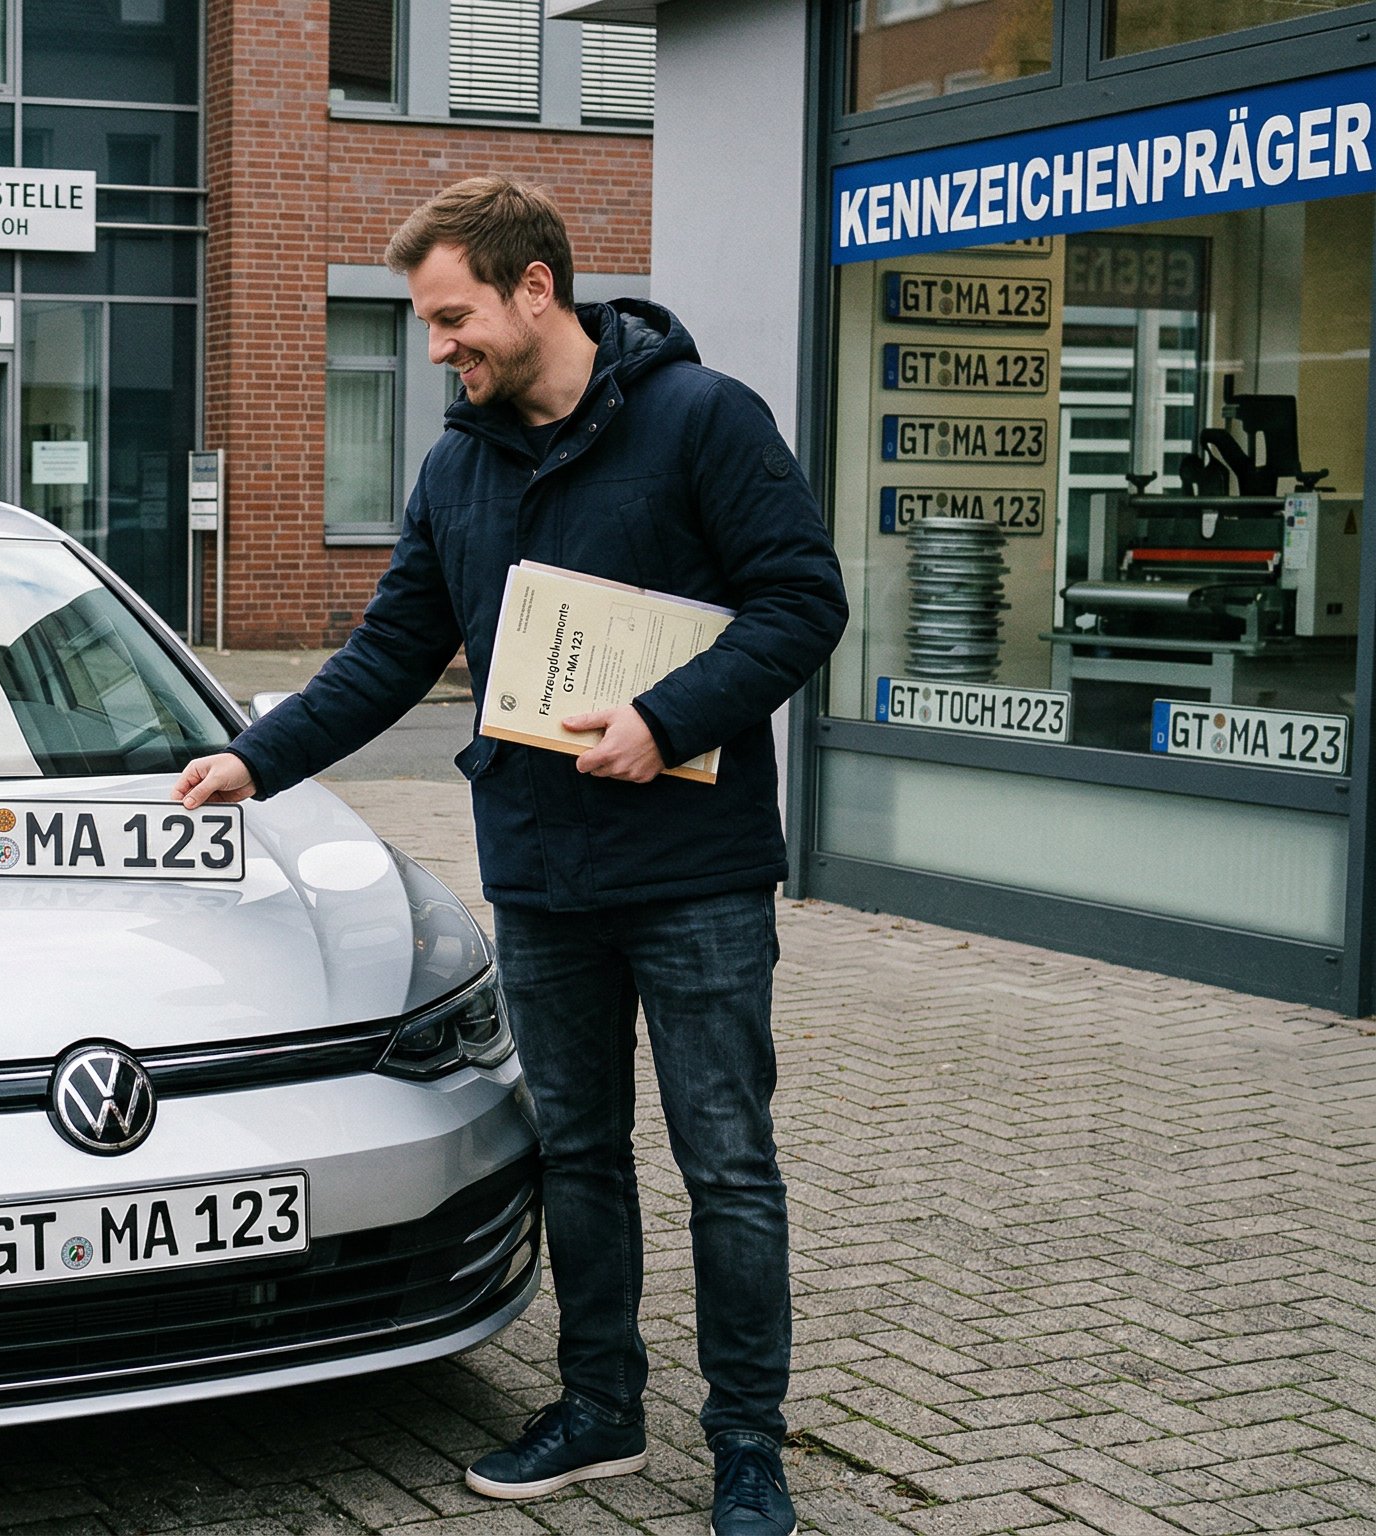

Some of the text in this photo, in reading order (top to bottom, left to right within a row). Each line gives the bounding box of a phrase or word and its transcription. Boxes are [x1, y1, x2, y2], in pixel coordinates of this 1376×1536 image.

[839, 102, 1372, 247] KENNZEICHENPRÄGER
[902, 279, 1047, 317] GT MA 123
[901, 351, 1045, 387] GT MA 123
[899, 422, 934, 455] GT
[953, 424, 987, 456] MA
[994, 425, 1043, 457] 123
[993, 496, 1042, 527] 123
[562, 630, 584, 693] GT-MA 123
[890, 685, 1065, 734] GT TOCH 1223
[1171, 711, 1209, 750] GT
[1229, 717, 1269, 757] MA
[1278, 721, 1341, 764] 123
[25, 811, 105, 867] MA
[122, 813, 235, 869] 123
[100, 1200, 180, 1264] MA
[194, 1185, 299, 1253] 123
